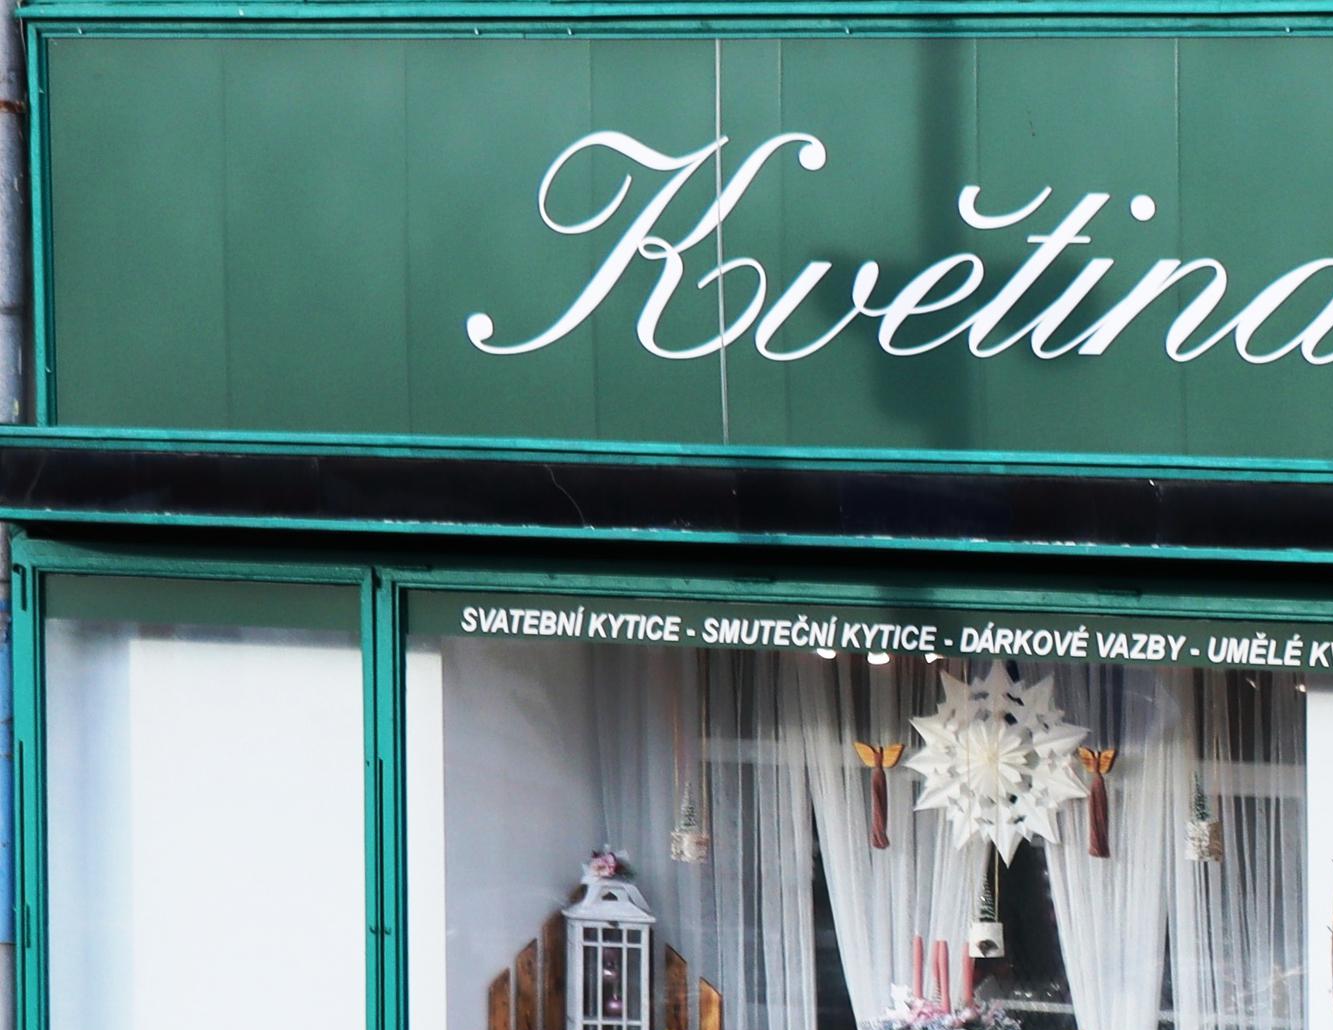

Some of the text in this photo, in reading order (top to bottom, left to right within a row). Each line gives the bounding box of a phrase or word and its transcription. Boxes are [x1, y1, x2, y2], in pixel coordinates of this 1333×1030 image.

[460, 605, 585, 637] SVATEBNÍ
[587, 611, 682, 642] KYTICE
[701, 613, 838, 648] SMUTEČNÍ
[841, 621, 937, 651] KYTICE
[960, 621, 1090, 657] DÁRKOVÉ
[1096, 631, 1187, 661] VAZBY
[1207, 631, 1304, 666] UMĚLÉ
